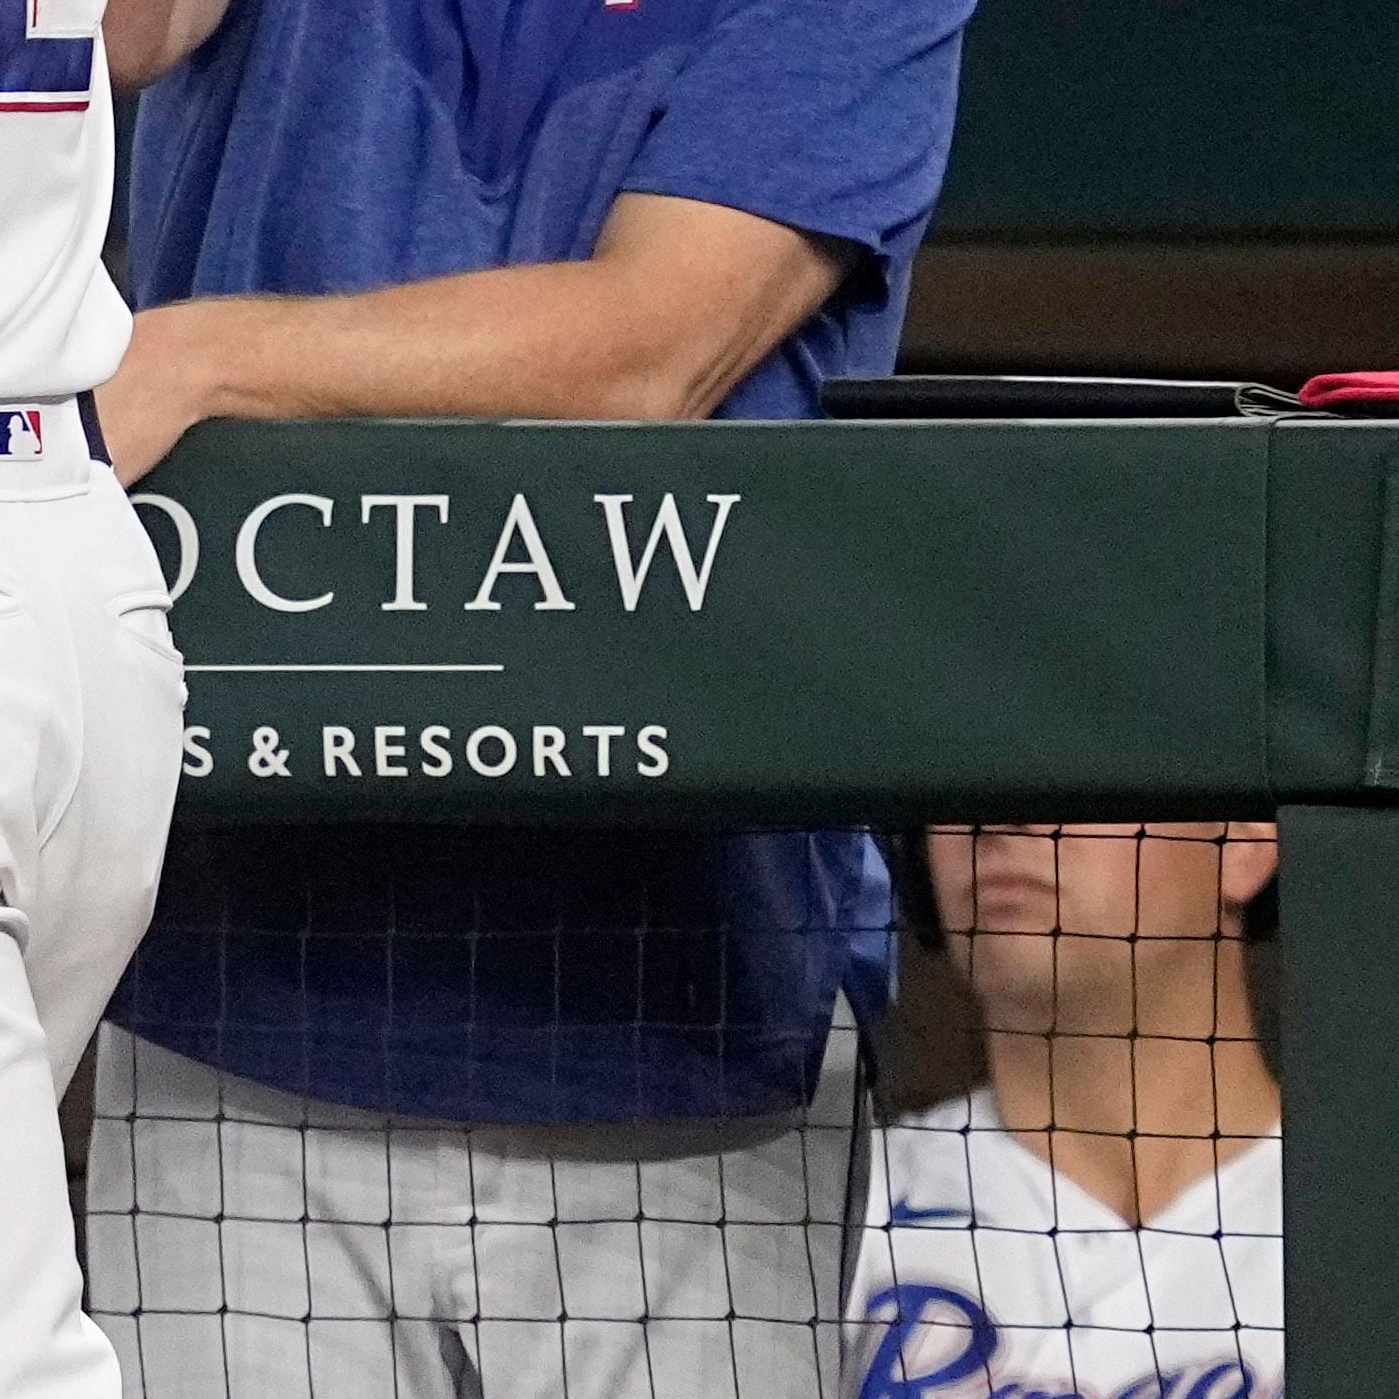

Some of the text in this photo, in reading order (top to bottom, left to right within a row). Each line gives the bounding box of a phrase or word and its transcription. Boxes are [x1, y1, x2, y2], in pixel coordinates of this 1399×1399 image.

[129, 491, 742, 613] OCTAW
[247, 726, 292, 778] &
[322, 725, 670, 778] RESORTS
